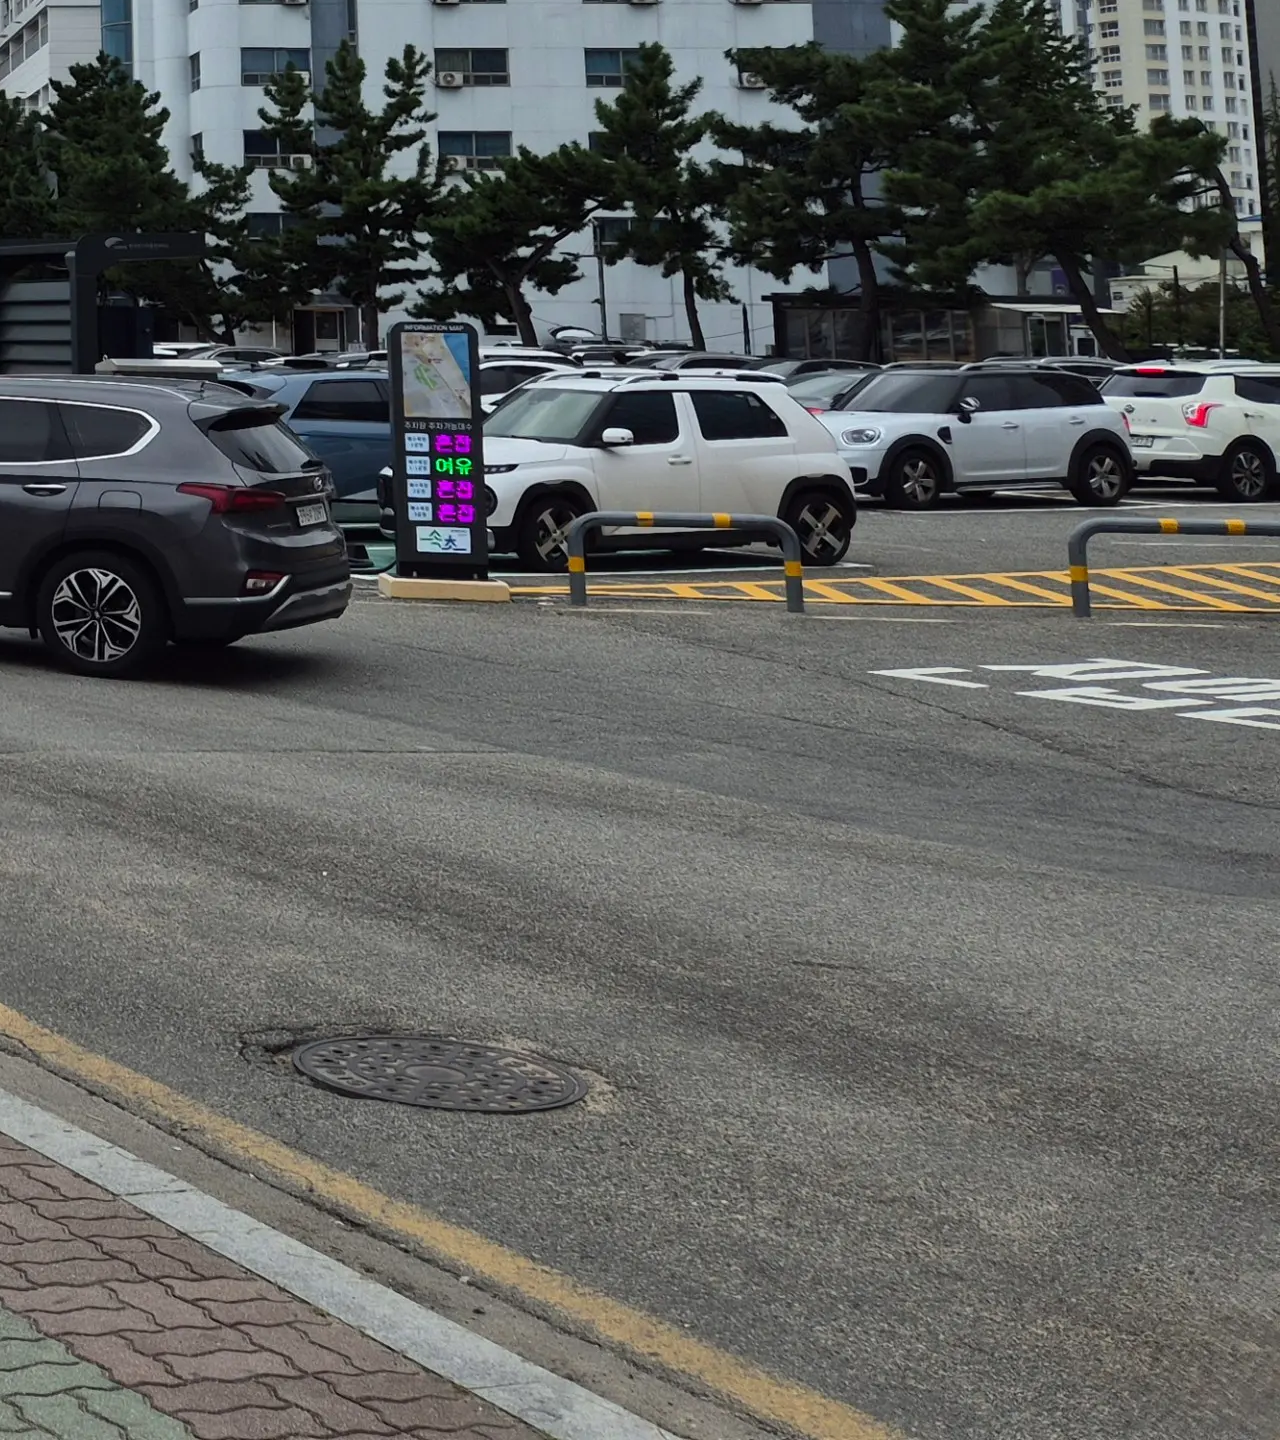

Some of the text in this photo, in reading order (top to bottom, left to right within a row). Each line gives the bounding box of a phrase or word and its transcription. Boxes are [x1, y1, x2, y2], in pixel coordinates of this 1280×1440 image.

[404, 421, 427, 430] 주차장
[435, 434, 472, 453] 혼잡
[435, 457, 473, 475] 여유
[437, 480, 474, 499] 혼잡
[438, 503, 475, 523] 혼잡
